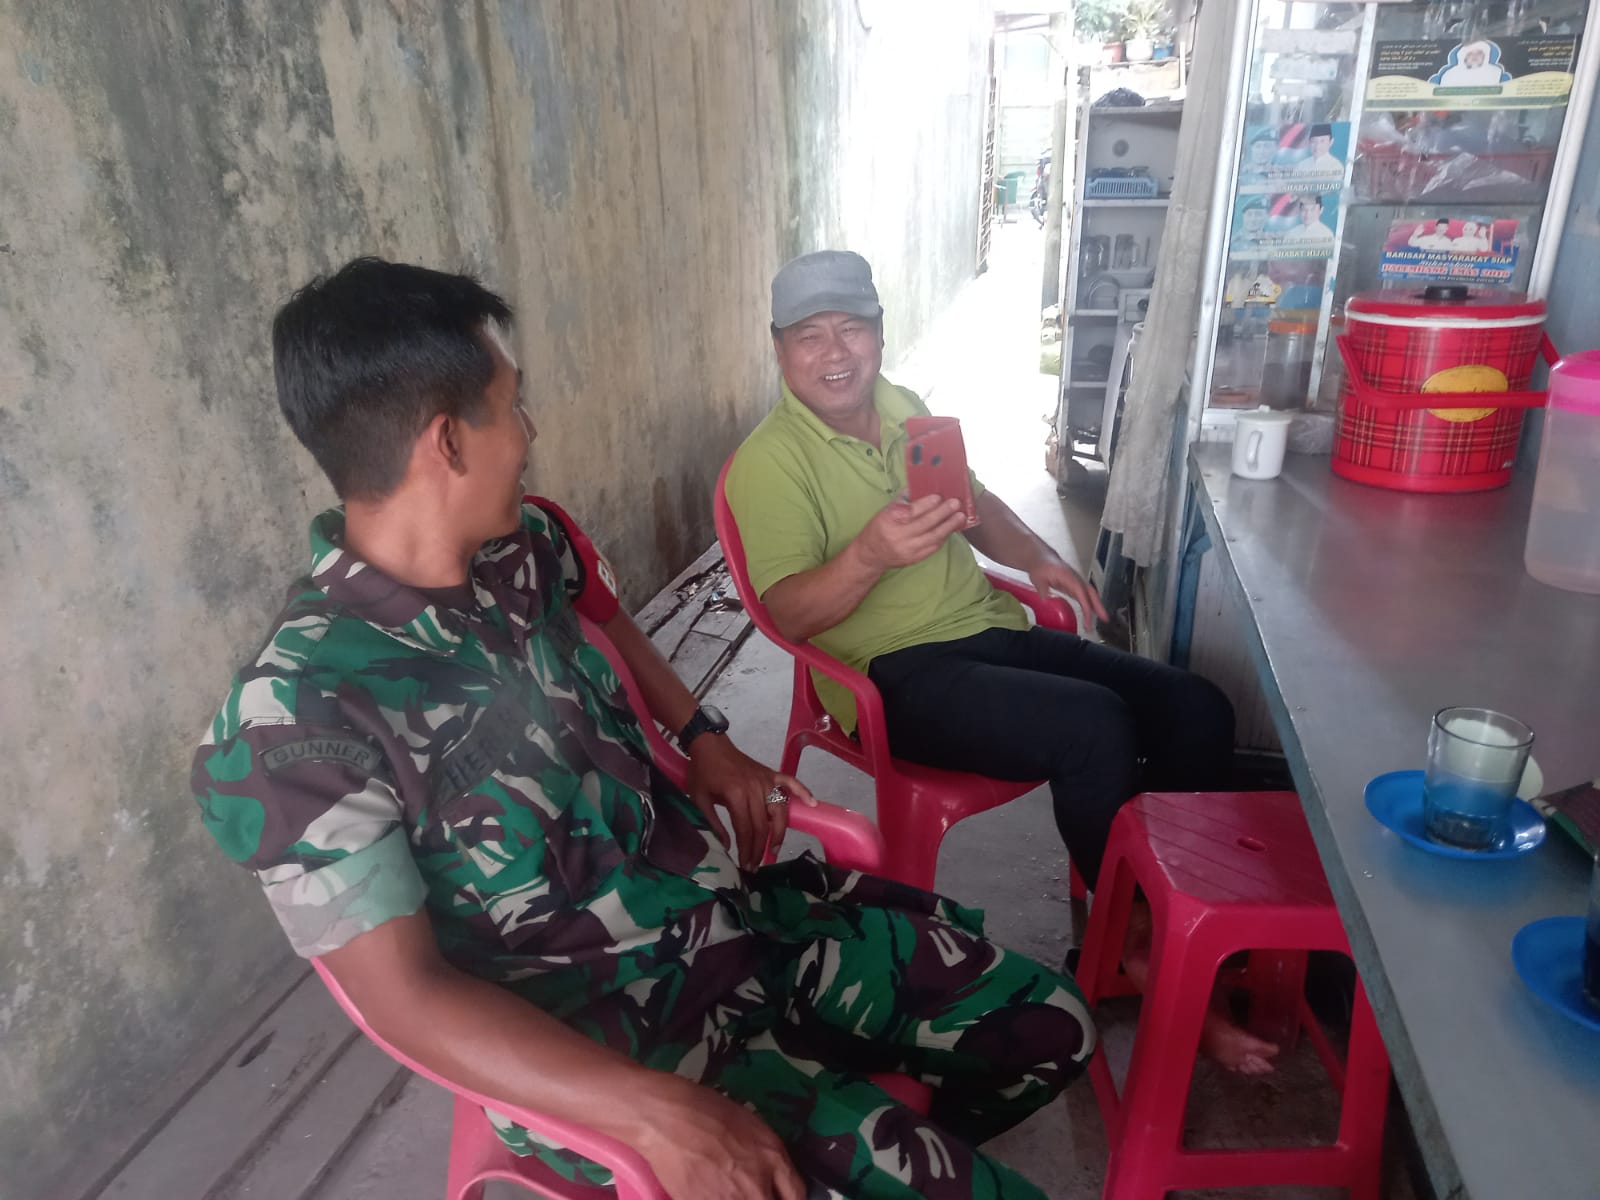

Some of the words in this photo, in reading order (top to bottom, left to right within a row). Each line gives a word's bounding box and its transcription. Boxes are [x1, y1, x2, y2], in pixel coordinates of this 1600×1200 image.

[1280, 184, 1313, 192] AHABAT
[1427, 254, 1489, 263] MASYARAKAT
[1491, 256, 1513, 264] SIAP
[273, 741, 369, 764] GUNNER
